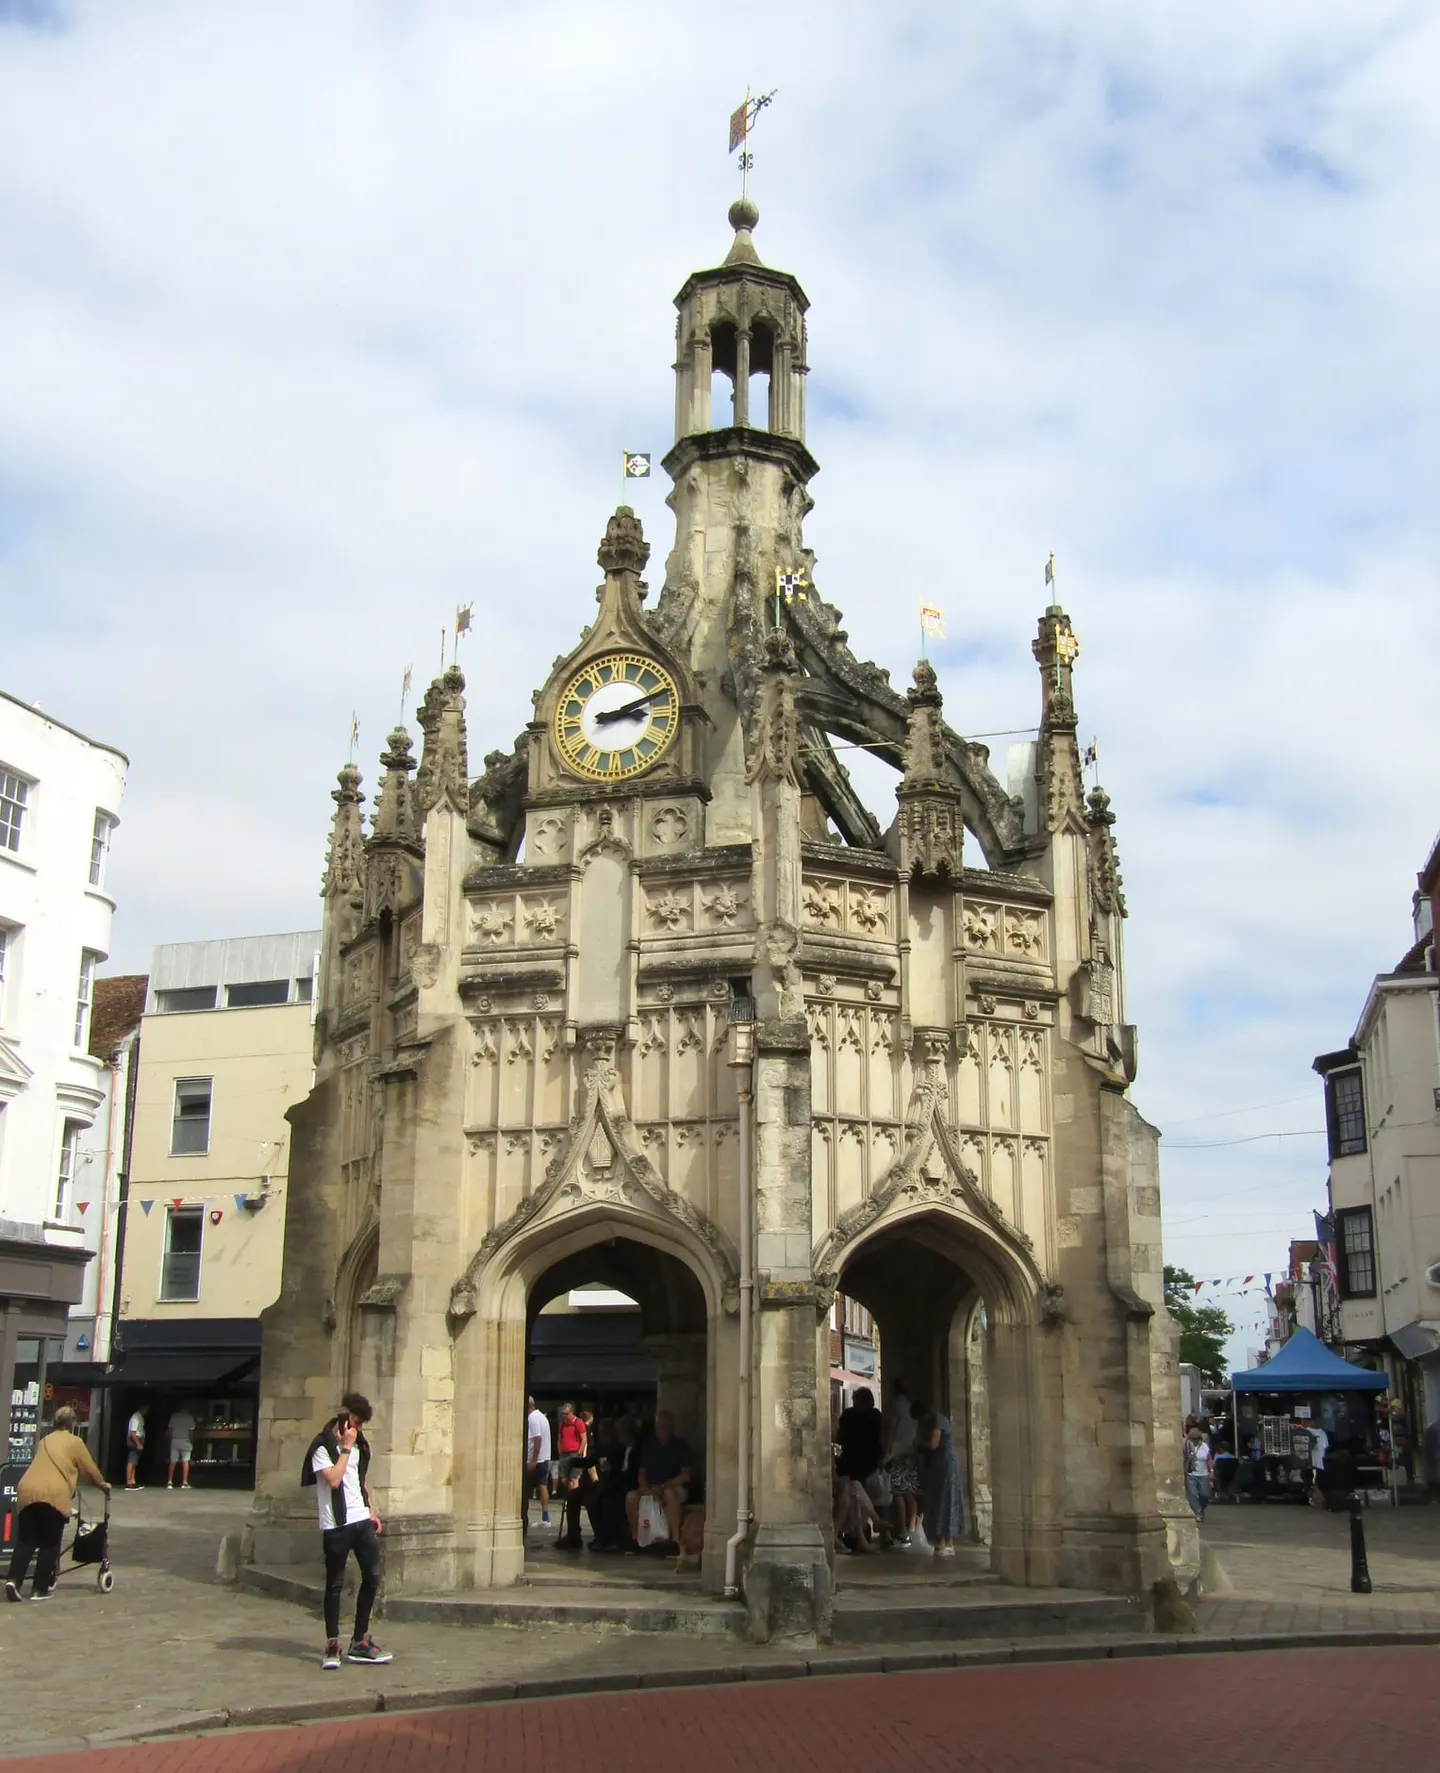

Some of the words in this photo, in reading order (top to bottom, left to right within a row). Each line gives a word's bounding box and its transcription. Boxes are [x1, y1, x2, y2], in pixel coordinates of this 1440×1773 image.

[610, 662, 626, 682] XII
[634, 667, 646, 684] I
[652, 706, 671, 718] III
[566, 732, 587, 754] VIII
[583, 747, 601, 768] VII
[609, 751, 621, 771] VI
[632, 746, 646, 764] V
[3, 1486, 18, 1495] EL
